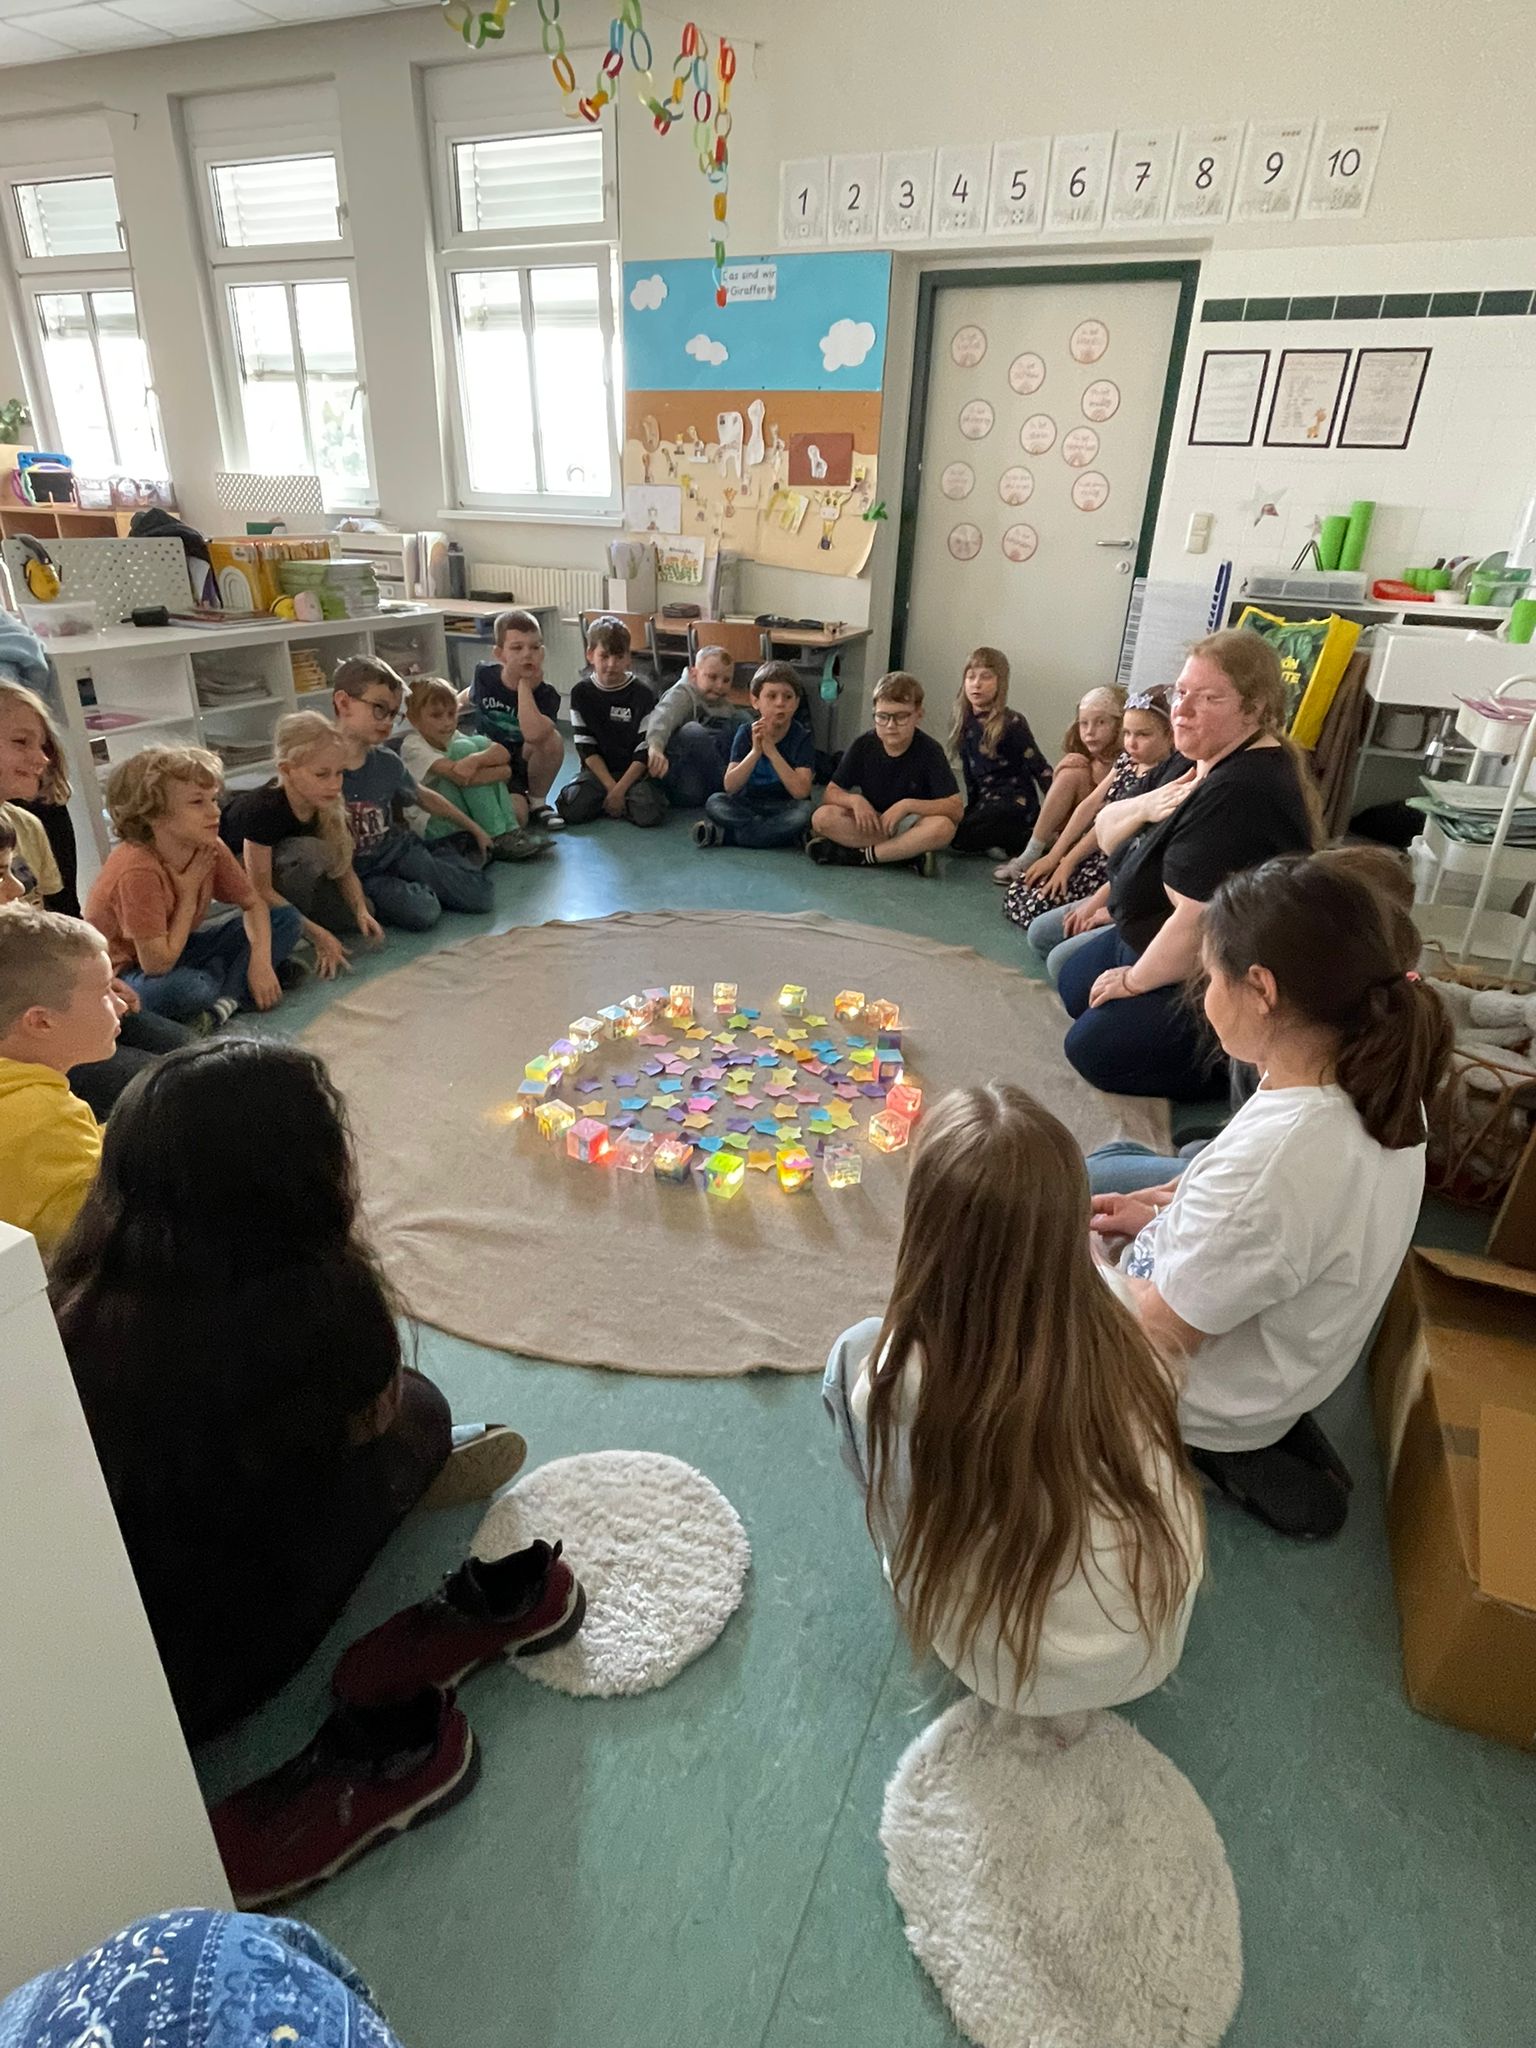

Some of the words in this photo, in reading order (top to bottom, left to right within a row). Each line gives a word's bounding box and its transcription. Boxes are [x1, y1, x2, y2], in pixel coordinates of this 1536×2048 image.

[1135, 161, 1152, 192] 7
[1195, 156, 1215, 190] 8
[1264, 151, 1284, 185] 9
[1328, 148, 1361, 178] 10
[847, 183, 861, 211] 2
[899, 180, 915, 209] 3
[951, 173, 969, 204] 4
[1010, 169, 1028, 201] 5
[1069, 166, 1087, 198] 6
[798, 187, 808, 216] 1
[742, 270, 759, 279] sind
[763, 270, 776, 279] wir
[730, 285, 767, 296] Giraffen
